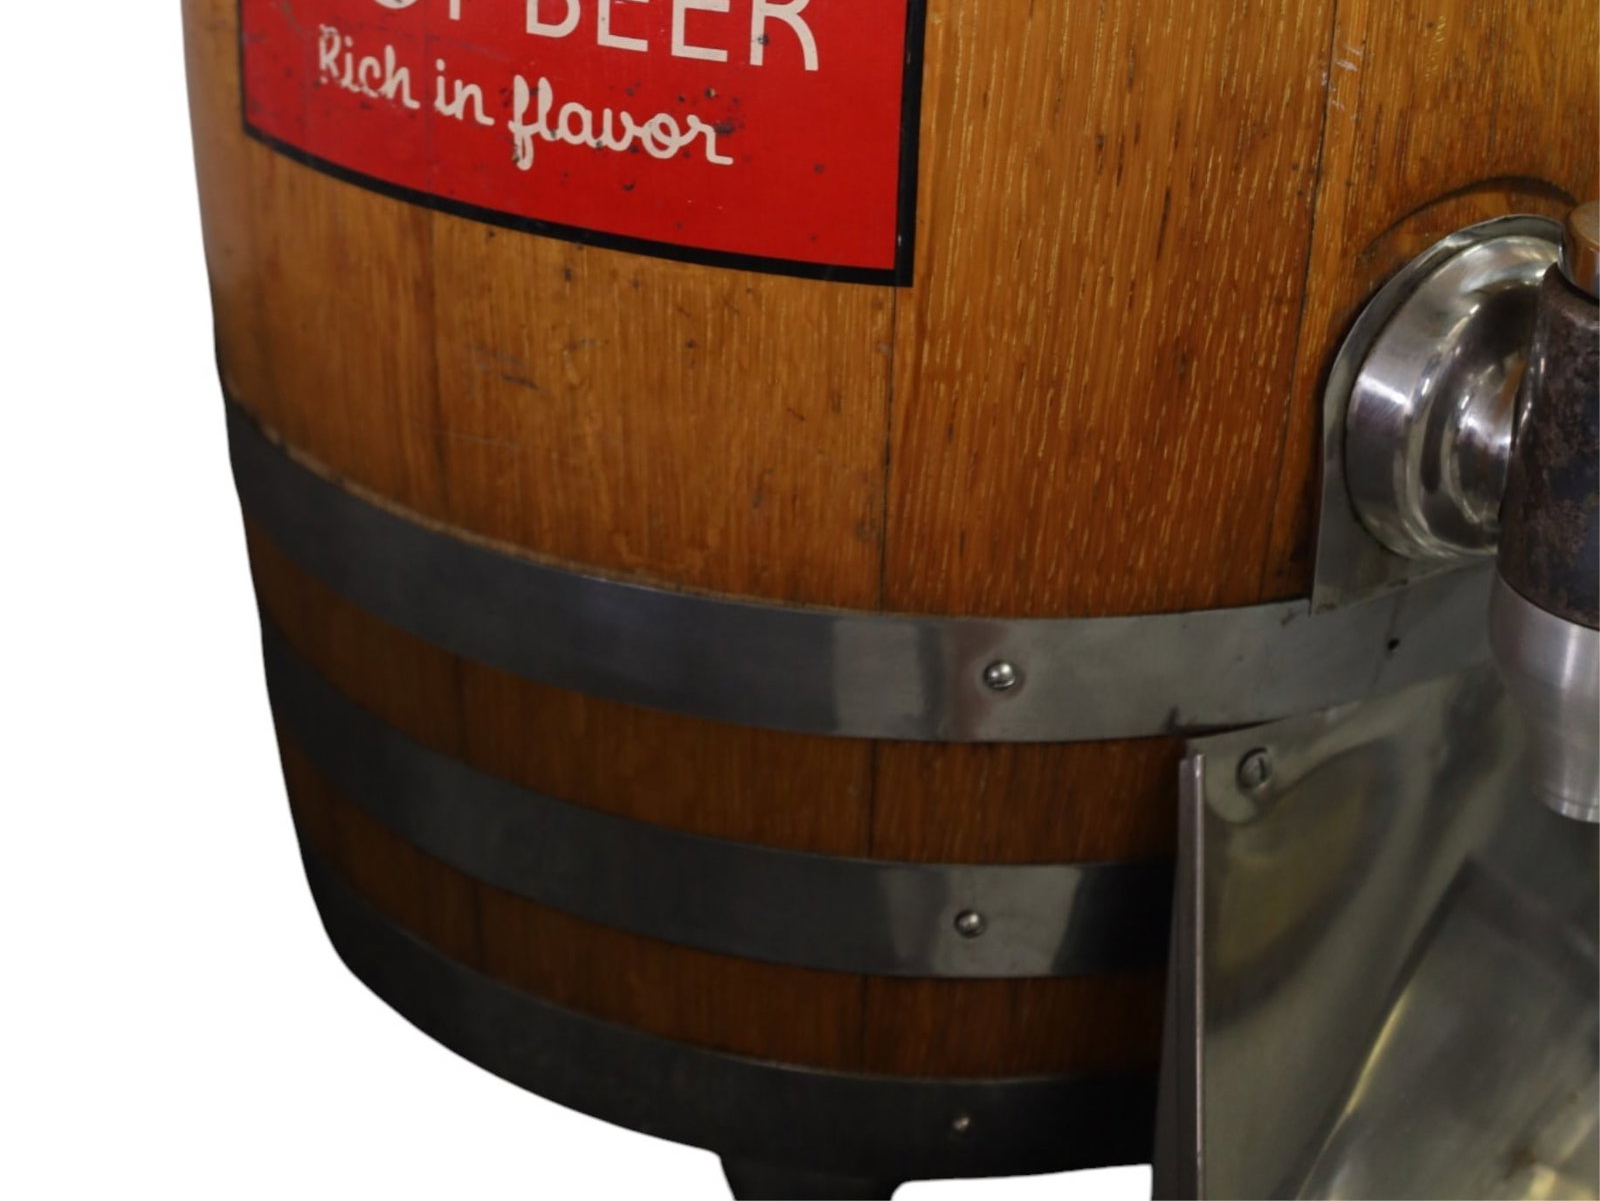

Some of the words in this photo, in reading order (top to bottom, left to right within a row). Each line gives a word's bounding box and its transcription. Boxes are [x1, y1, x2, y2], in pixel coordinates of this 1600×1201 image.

[317, 23, 420, 110] Rich
[433, 58, 495, 126] in
[507, 74, 733, 171] flavor
